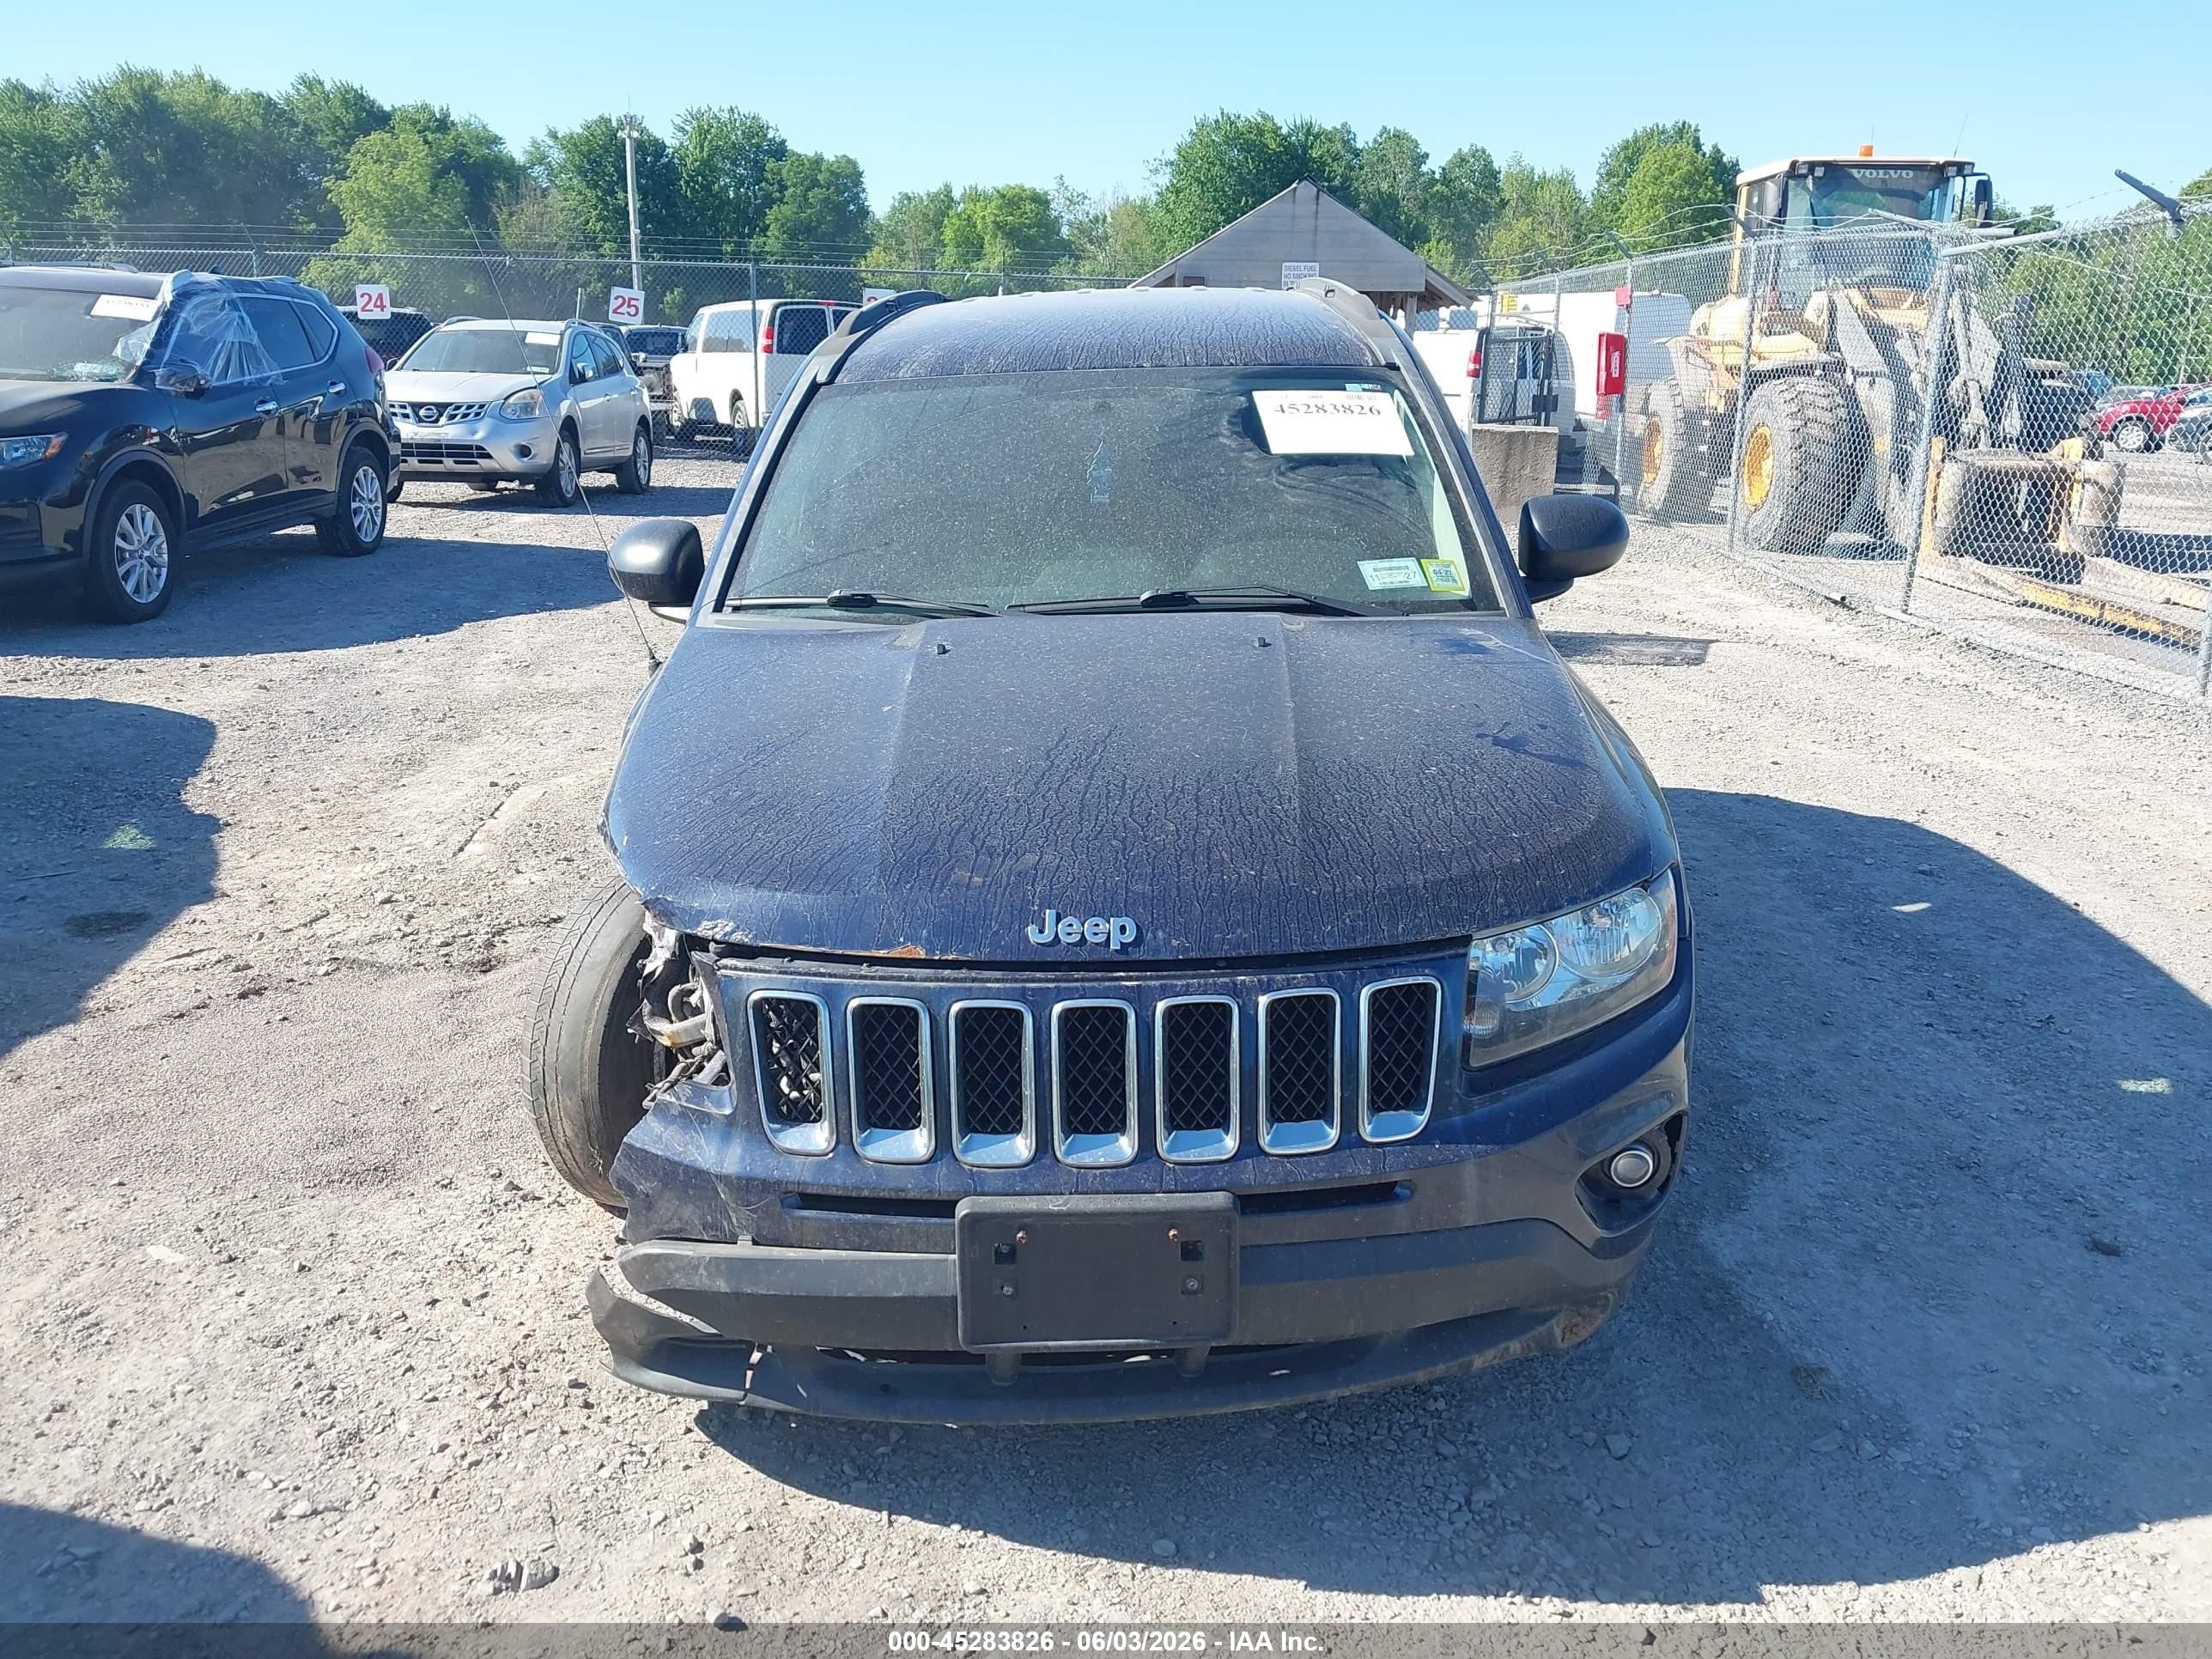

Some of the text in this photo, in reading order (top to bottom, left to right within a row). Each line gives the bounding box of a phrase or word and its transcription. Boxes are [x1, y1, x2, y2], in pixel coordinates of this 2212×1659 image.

[1850, 168, 1914, 179] VOLVO
[360, 292, 386, 313] 24
[611, 295, 640, 318] 25
[1274, 403, 1381, 416] 45283826
[1027, 908, 1137, 950] Jeep
